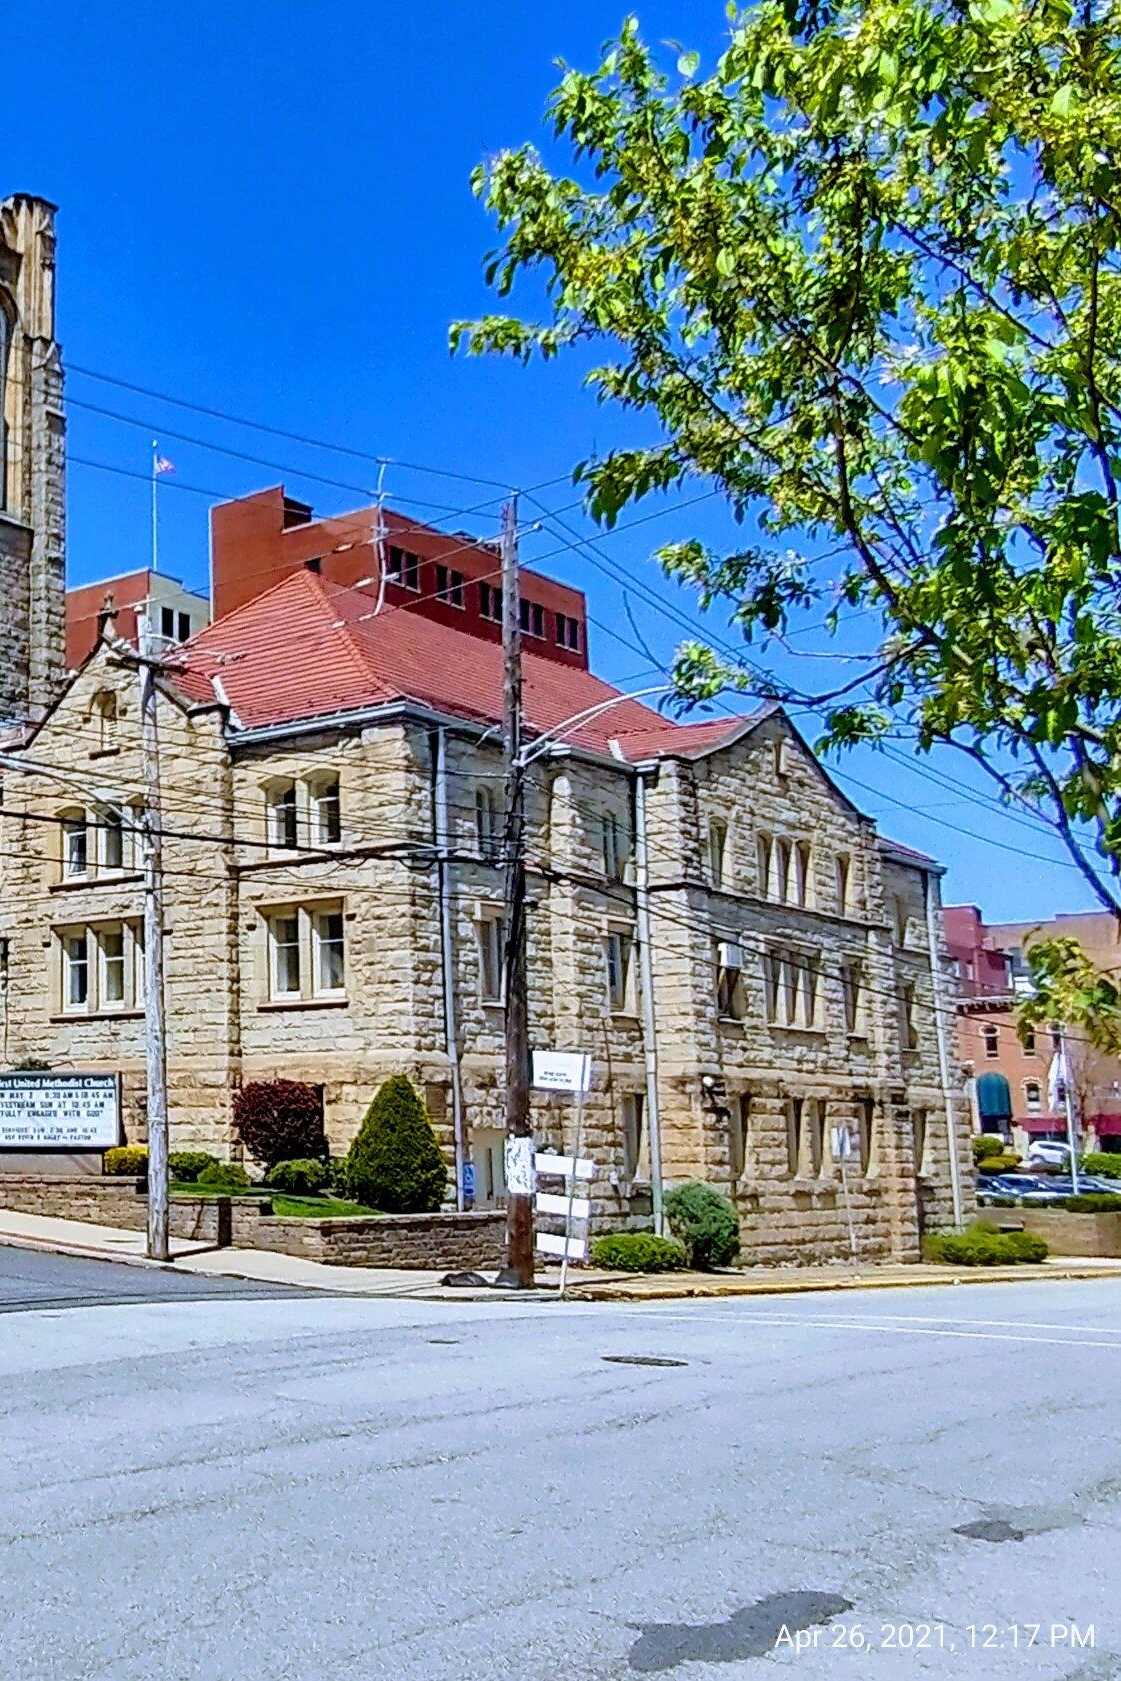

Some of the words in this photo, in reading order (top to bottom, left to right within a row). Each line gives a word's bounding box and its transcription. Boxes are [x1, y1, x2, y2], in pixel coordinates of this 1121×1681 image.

[13, 1078, 41, 1088] United
[42, 1077, 83, 1088] Methodist
[84, 1077, 114, 1088] Church
[63, 1091, 73, 1099] AM
[103, 1091, 113, 1099] AM
[40, 1101, 53, 1109] SUN
